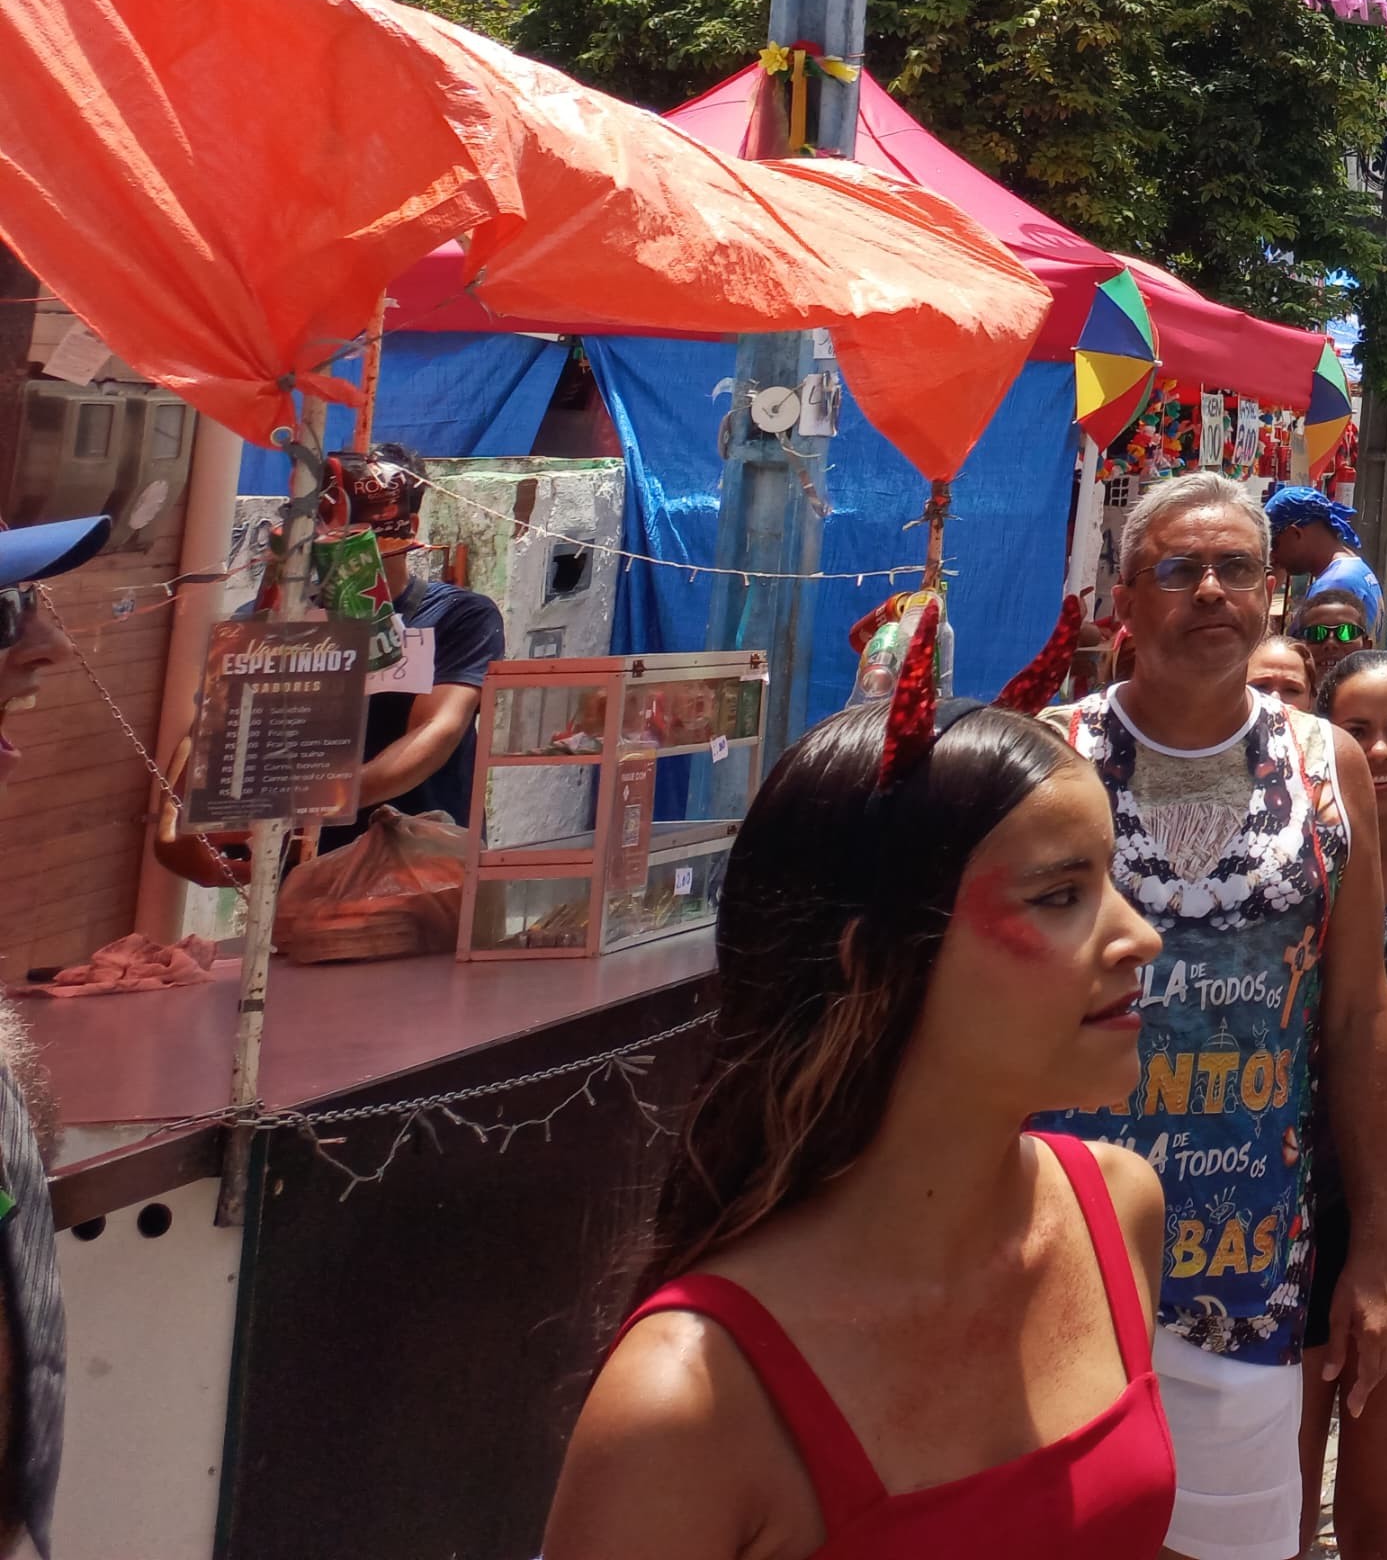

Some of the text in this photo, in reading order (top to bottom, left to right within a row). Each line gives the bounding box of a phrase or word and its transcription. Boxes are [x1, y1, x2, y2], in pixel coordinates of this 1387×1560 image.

[222, 650, 357, 676] ESPETINHO?
[252, 680, 321, 693] SABORES
[1190, 962, 1208, 979] DE
[1194, 970, 1269, 1010] TODOS
[1266, 985, 1283, 1009] OS
[1120, 1048, 1292, 1116] NTOS
[1172, 1131, 1190, 1148] DE
[1175, 1141, 1252, 1181] TODOS
[1250, 1155, 1267, 1178] OS
[1169, 1214, 1278, 1278] BAS
